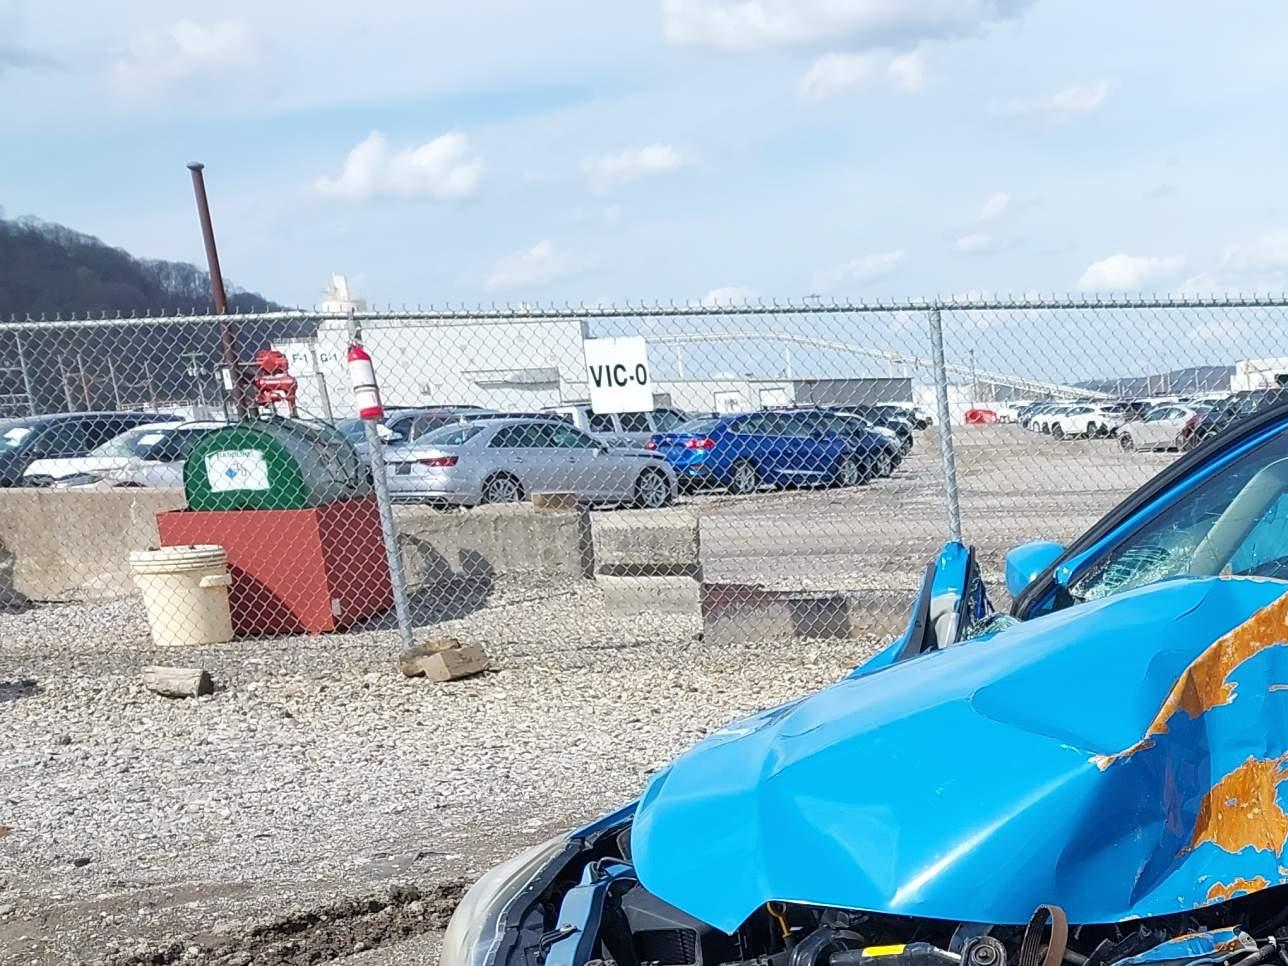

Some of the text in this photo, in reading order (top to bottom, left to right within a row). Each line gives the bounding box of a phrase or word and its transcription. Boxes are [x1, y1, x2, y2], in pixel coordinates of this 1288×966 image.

[292, 353, 308, 363] F-1
[320, 351, 338, 362] G-1
[589, 363, 648, 388] VIC-0
